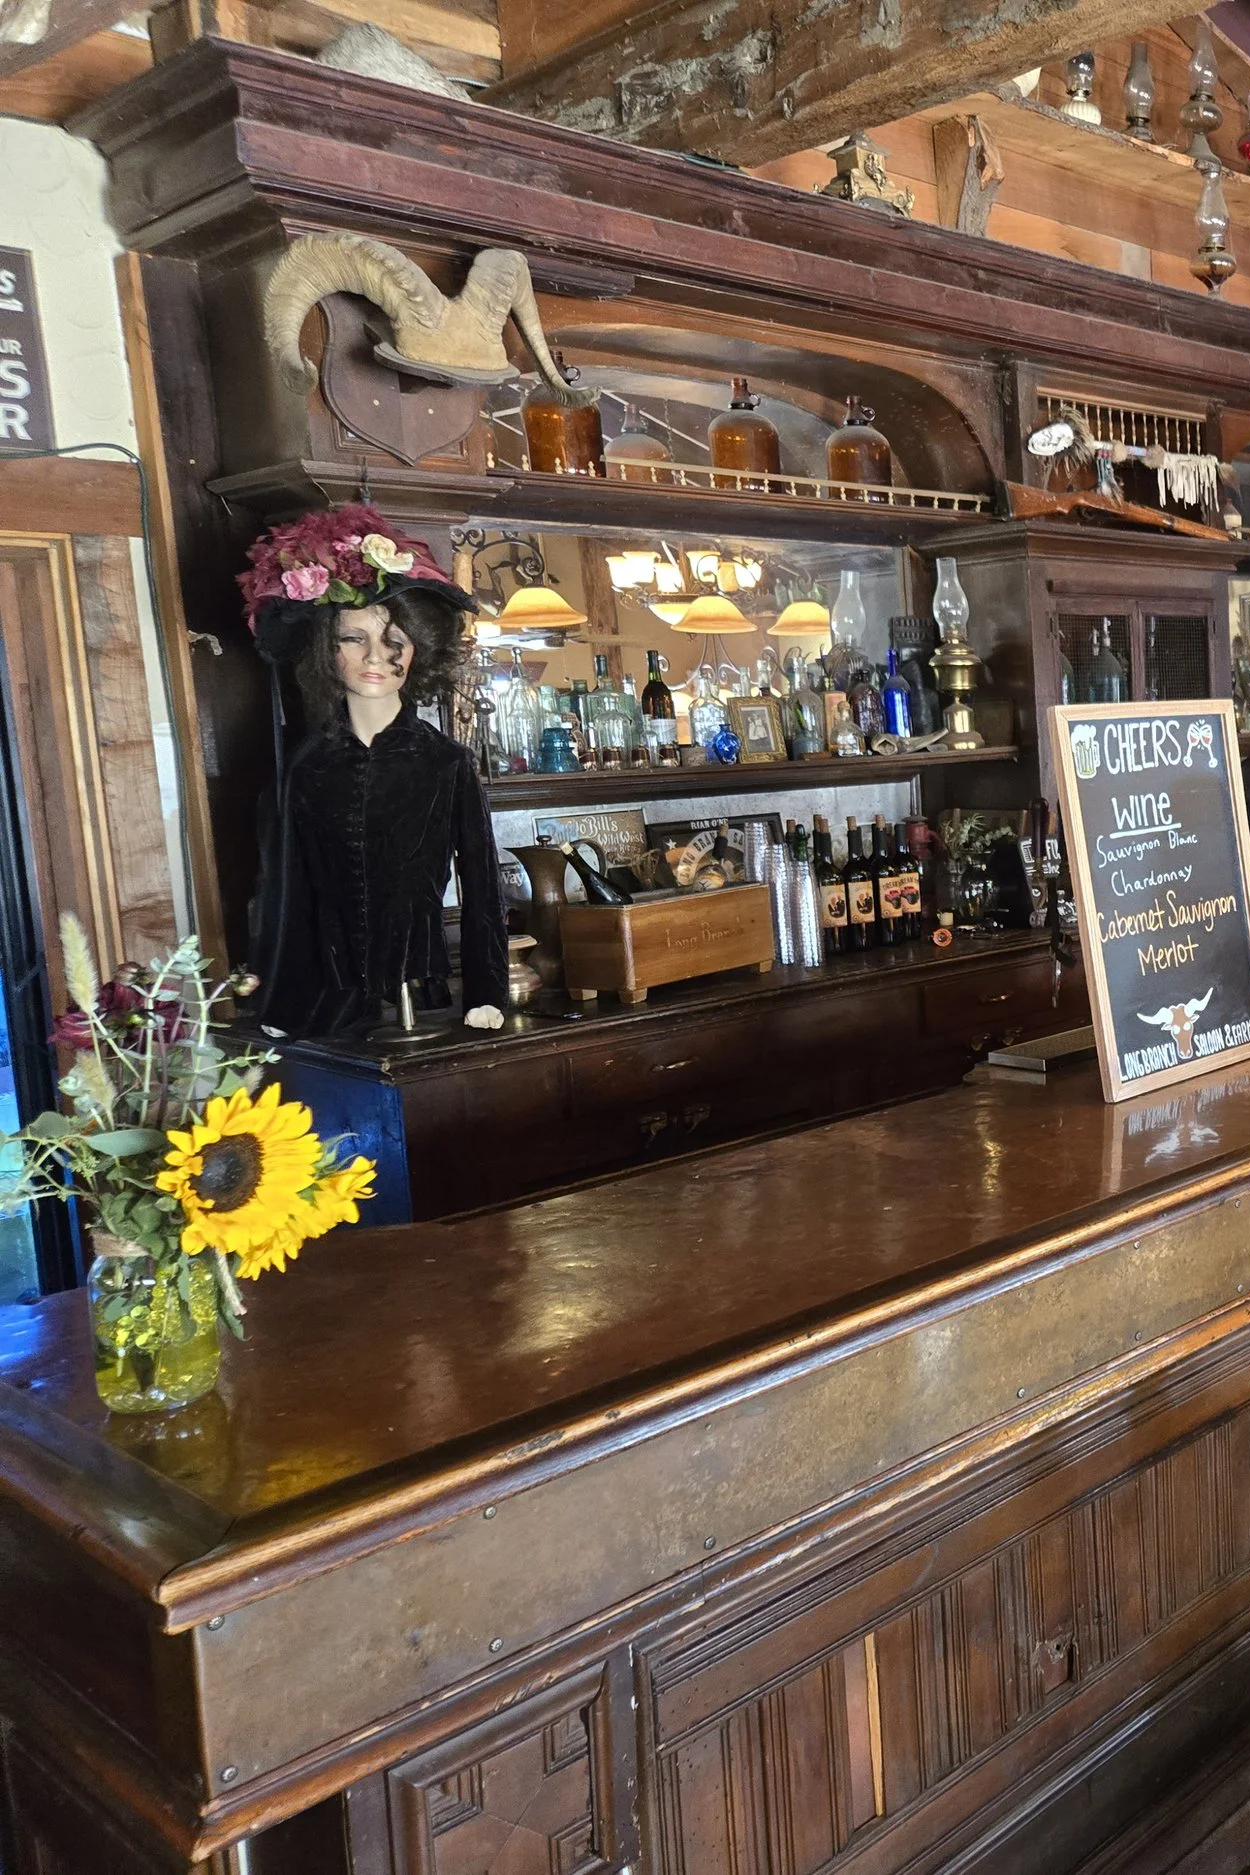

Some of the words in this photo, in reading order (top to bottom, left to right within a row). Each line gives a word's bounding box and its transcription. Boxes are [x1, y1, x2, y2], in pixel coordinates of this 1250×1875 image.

[1103, 720, 1182, 775] CHEERS
[584, 815, 619, 837] Bill's
[598, 833, 620, 846] Wild
[619, 830, 645, 844] West
[1096, 835, 1160, 868] Sauvignon
[1168, 830, 1198, 849] Blanc
[1111, 864, 1193, 896] Chardonnay
[1166, 890, 1237, 932] Sauvignon
[1137, 934, 1199, 976] Merlot
[1193, 1031, 1225, 1057] SALOON
